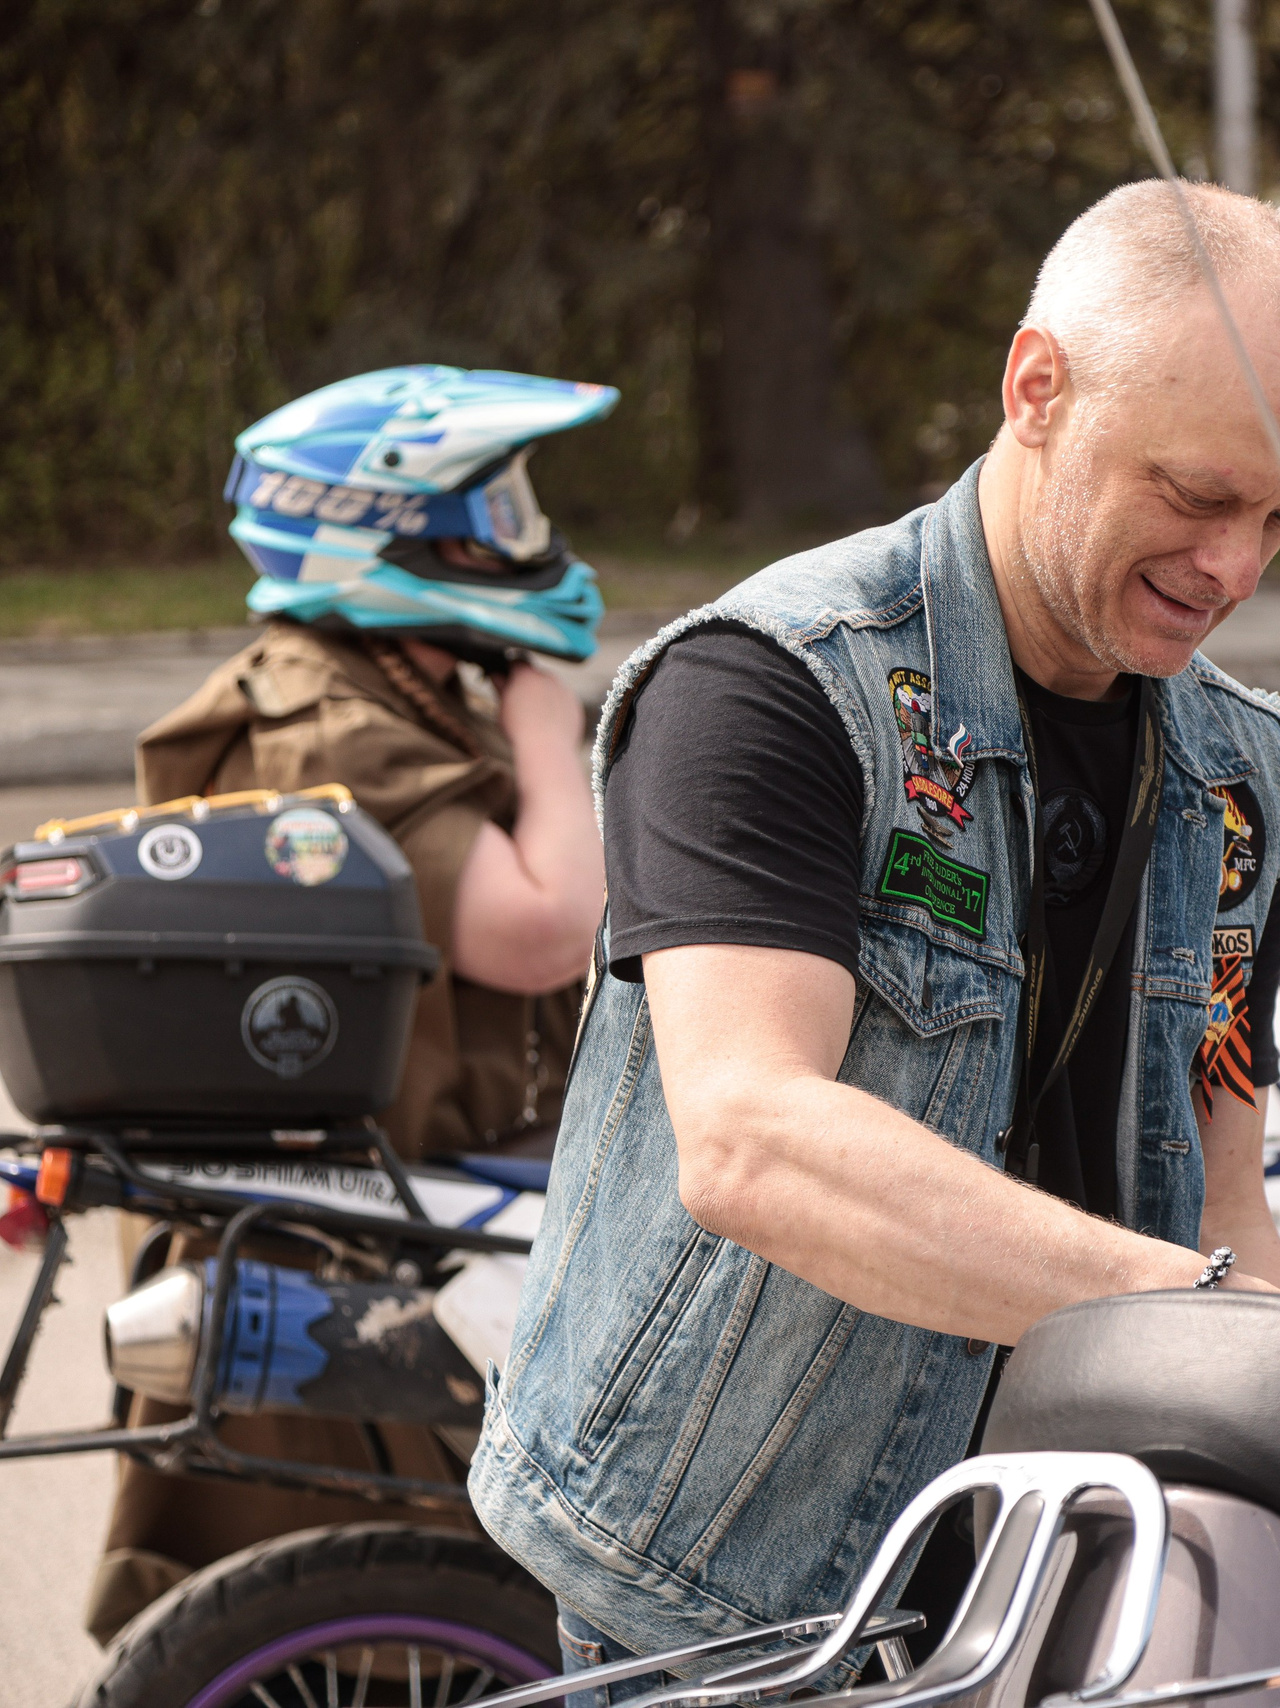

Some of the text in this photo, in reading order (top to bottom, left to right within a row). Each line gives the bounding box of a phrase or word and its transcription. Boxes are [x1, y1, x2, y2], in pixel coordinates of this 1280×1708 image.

[251, 471, 429, 535] 100%
[956, 760, 975, 797] 24 HOU
[1234, 857, 1257, 871] MFC
[1212, 932, 1249, 955] KOS
